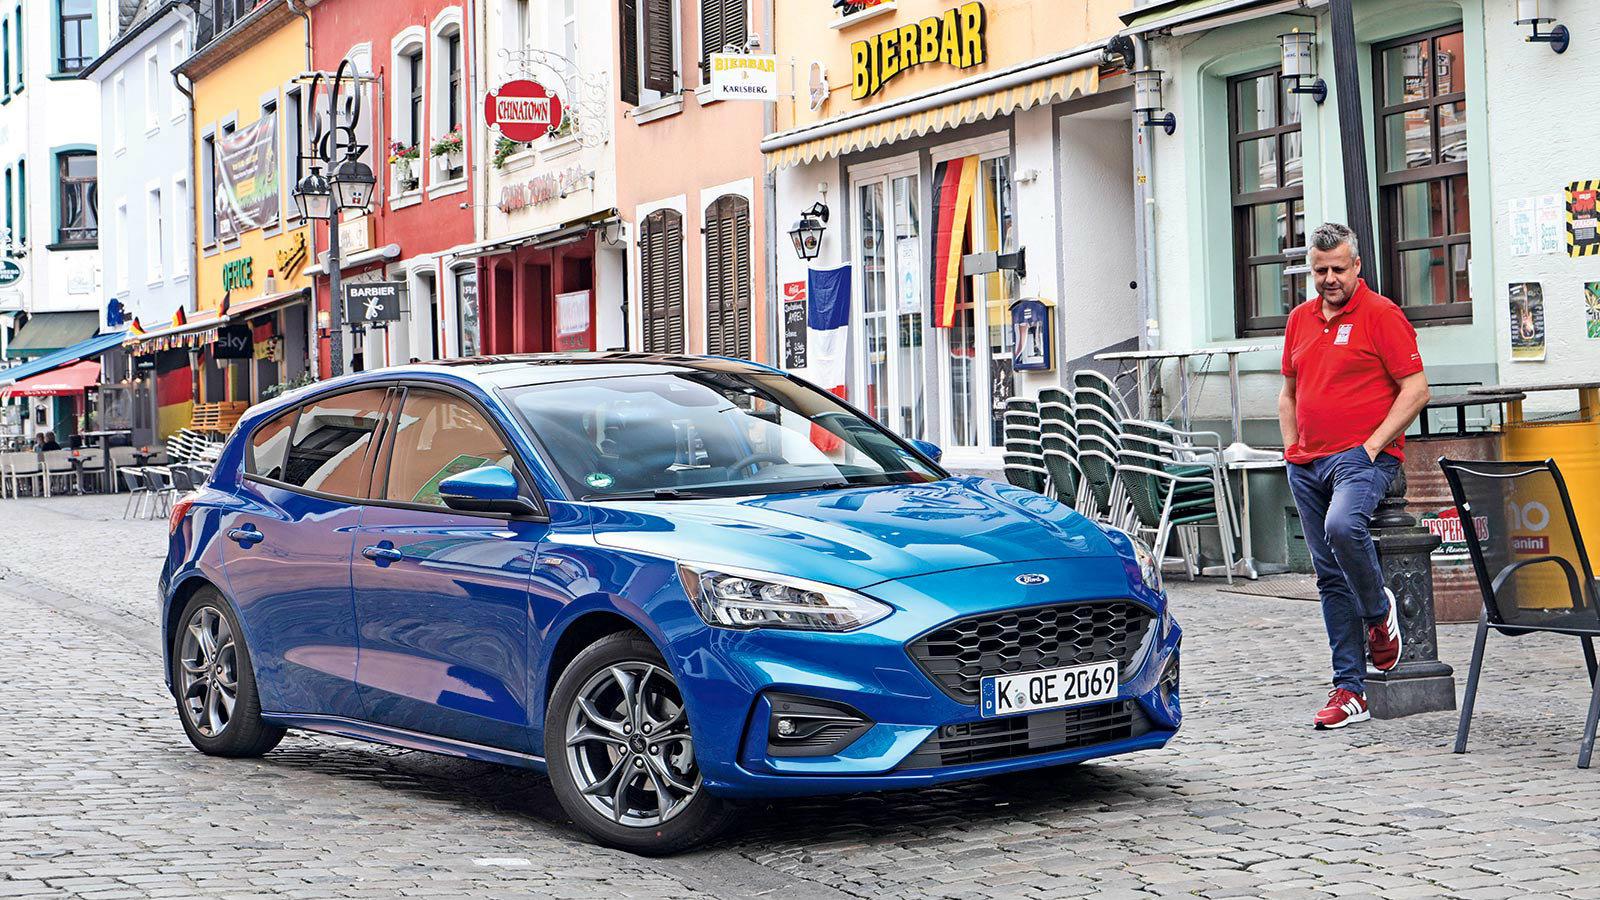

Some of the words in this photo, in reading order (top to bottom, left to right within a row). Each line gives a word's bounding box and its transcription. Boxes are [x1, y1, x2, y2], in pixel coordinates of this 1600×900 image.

[851, 1, 986, 100] BIERBAR
[714, 57, 775, 72] BIERBAR
[723, 84, 768, 94] KARLSBERG
[497, 100, 549, 121] CHINATOWN
[222, 256, 253, 292] OFFICE
[350, 286, 395, 297] BARBIER
[218, 332, 247, 351] sky
[1513, 538, 1544, 550] anini
[998, 680, 1012, 709] K
[1029, 675, 1058, 705] QE
[1064, 666, 1115, 700] 2069
[986, 700, 992, 709] D
